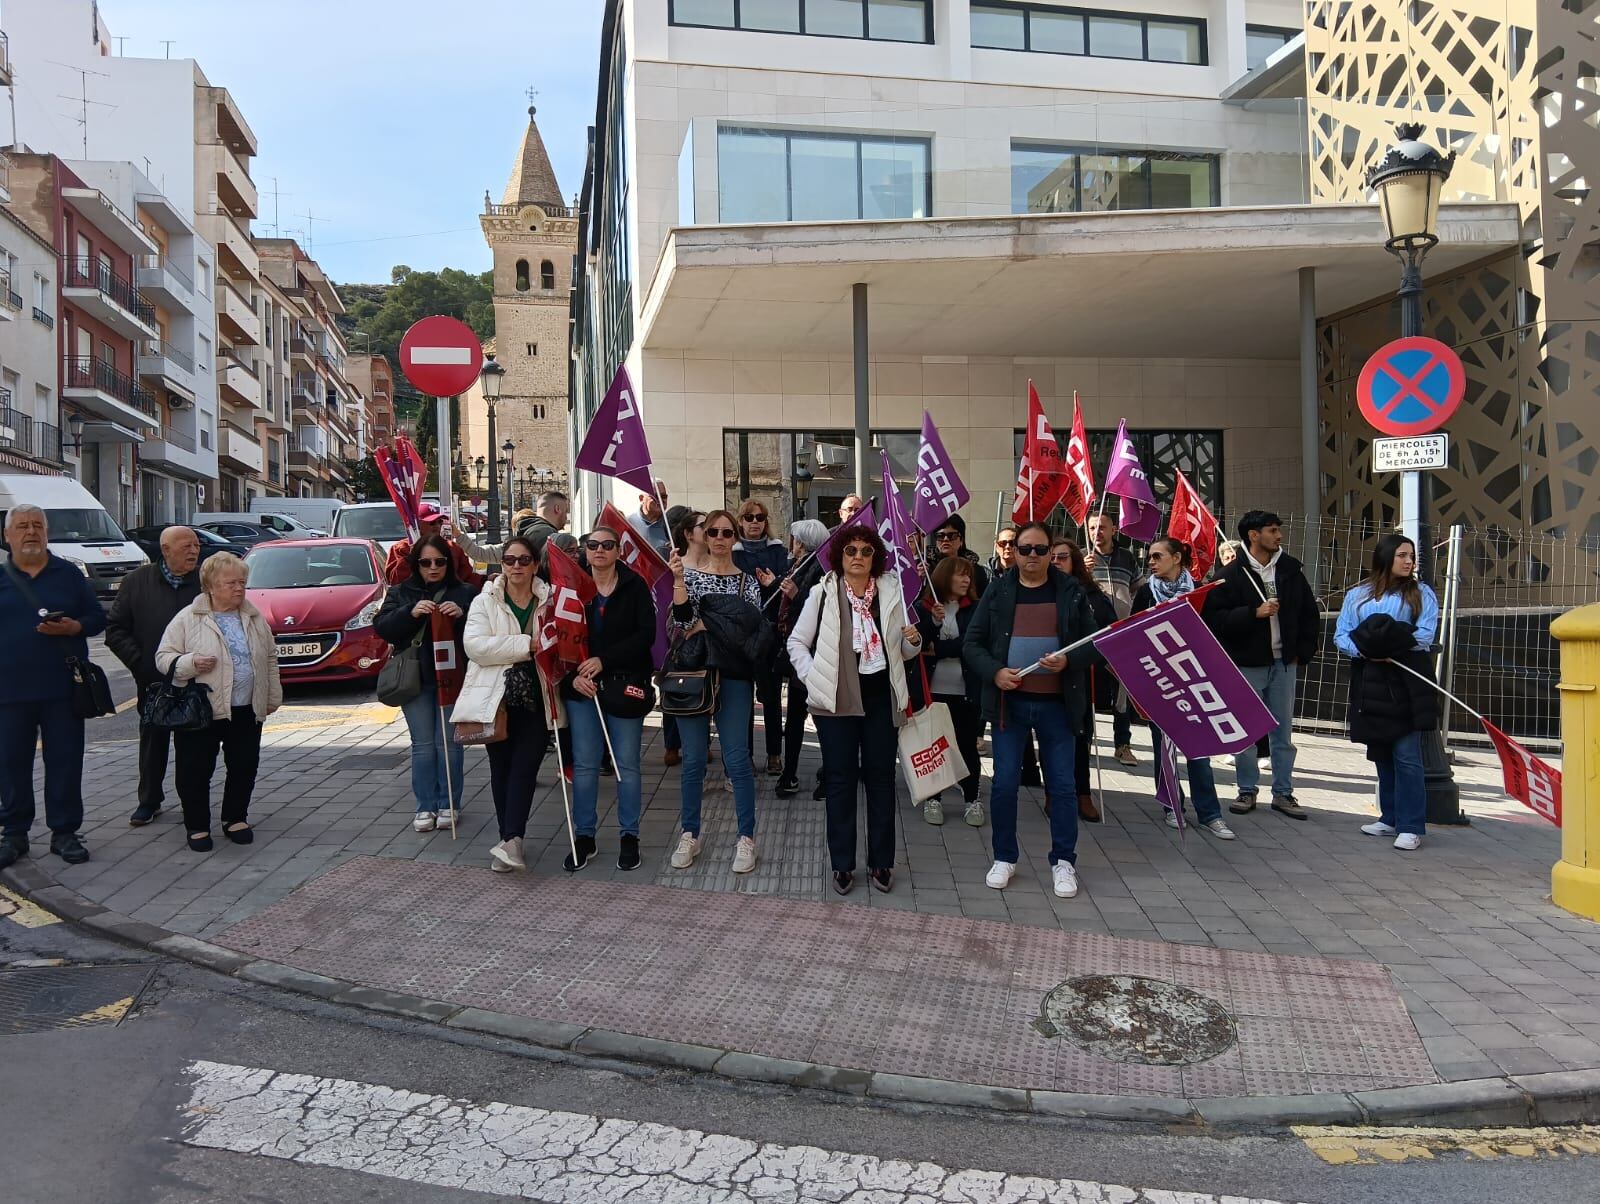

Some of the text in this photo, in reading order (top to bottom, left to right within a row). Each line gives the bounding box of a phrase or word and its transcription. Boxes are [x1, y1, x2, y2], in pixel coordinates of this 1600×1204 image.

[1381, 439, 1439, 450] MIERCOLES
[1379, 451, 1391, 459] DE
[1425, 448, 1440, 456] 15h
[1385, 457, 1434, 466] MERCADO
[298, 644, 318, 654] JGP
[1143, 620, 1249, 744] CCOO
[1139, 655, 1202, 724] mujer
